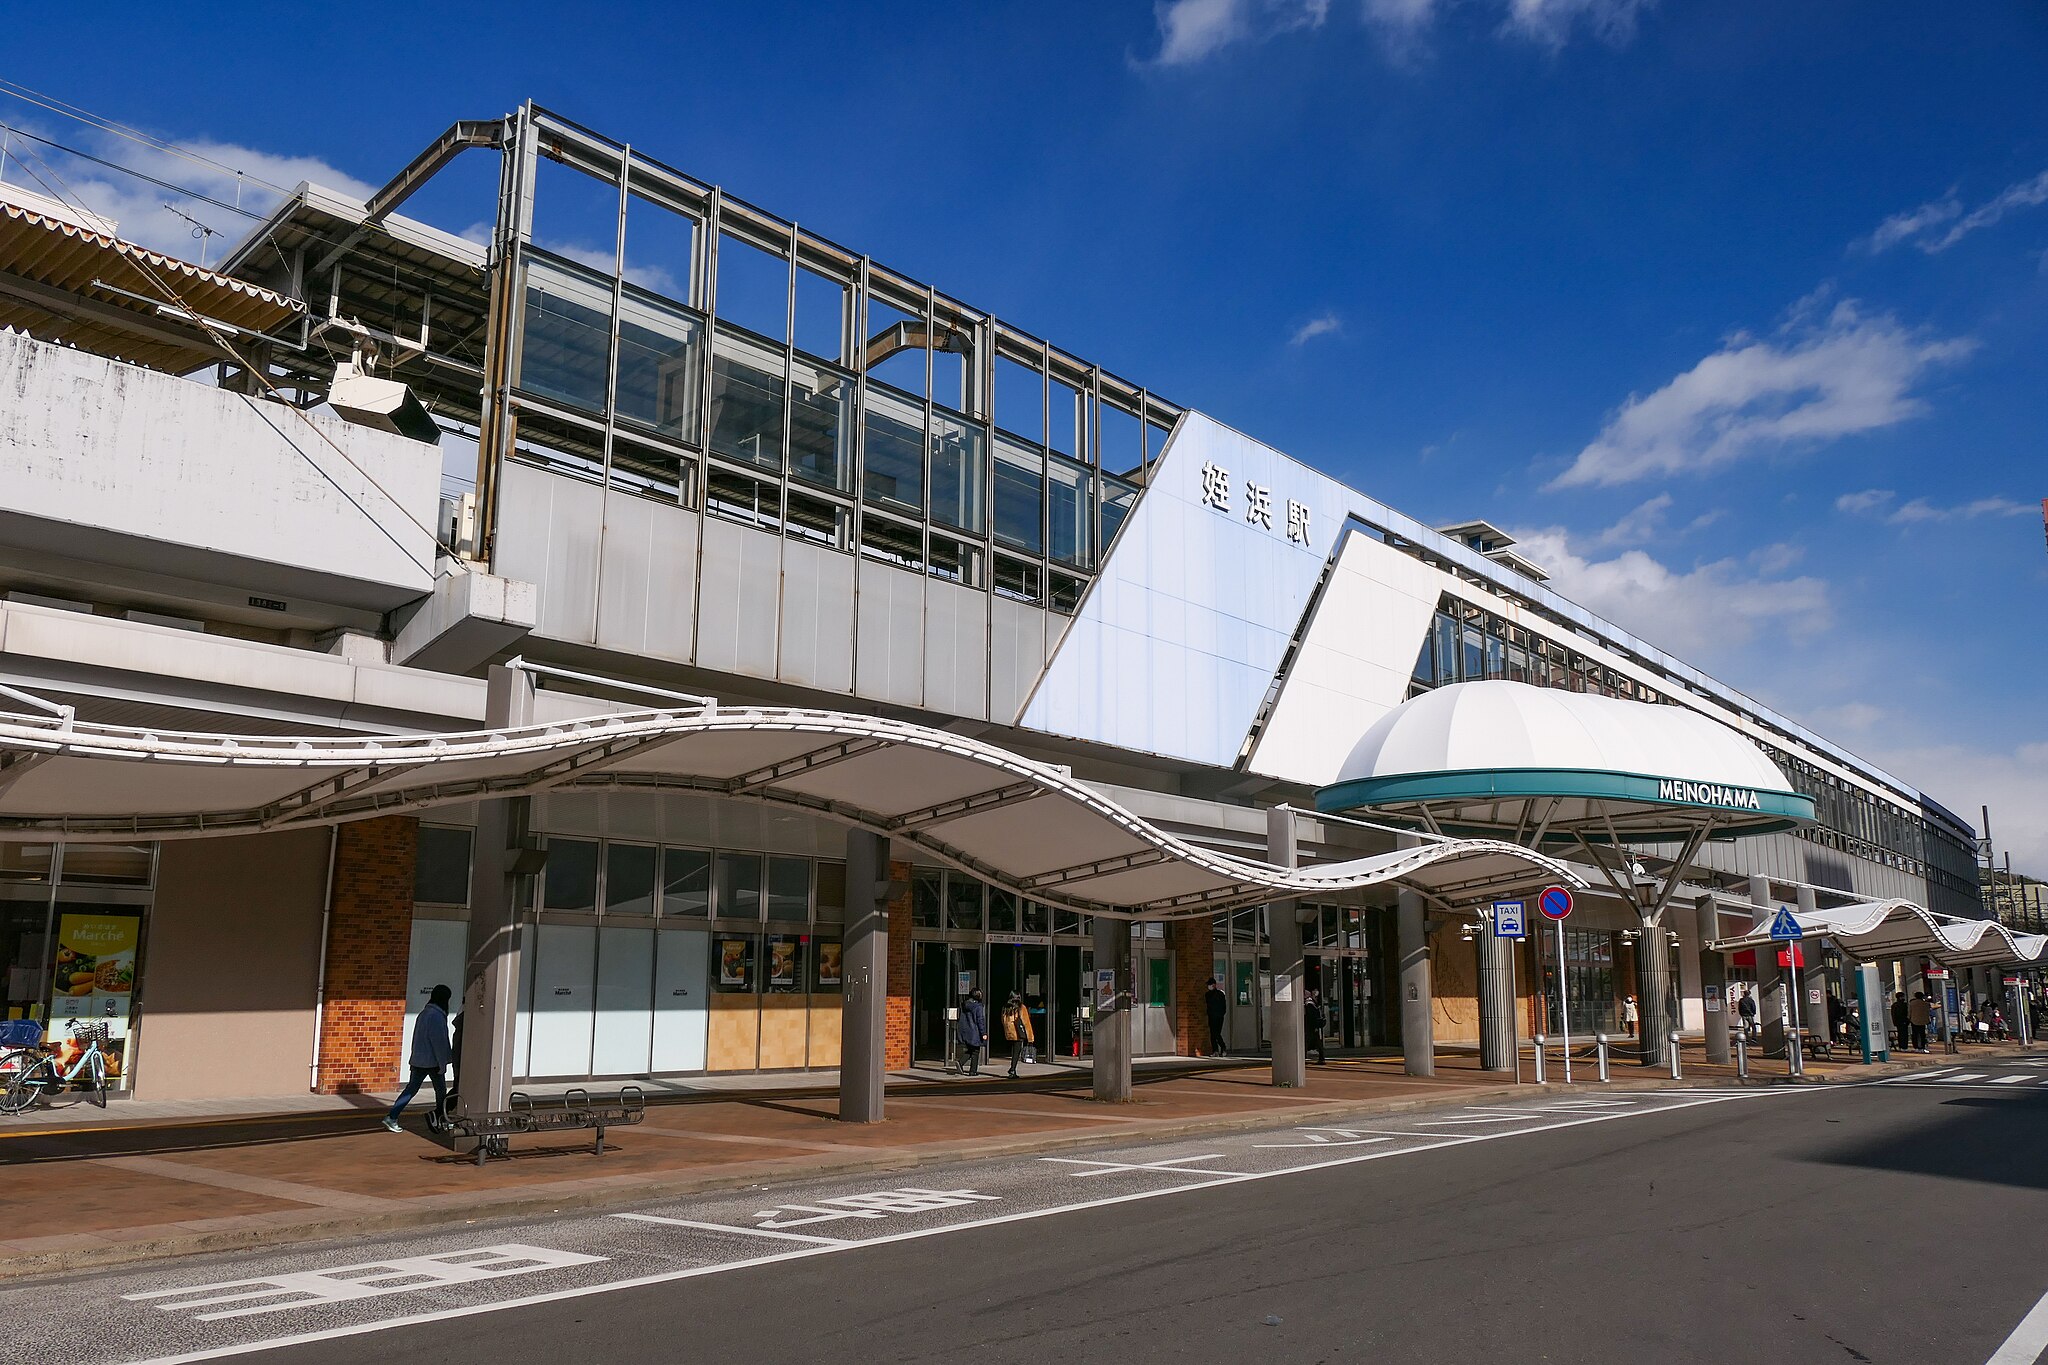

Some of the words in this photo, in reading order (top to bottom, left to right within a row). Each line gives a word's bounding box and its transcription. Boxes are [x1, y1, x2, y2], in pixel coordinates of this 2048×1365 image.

[1201, 459, 1311, 548] 姪浜駅
[1659, 779, 1761, 810] MEINOHAMA
[1499, 906, 1518, 915] TAXI
[73, 929, 125, 941] Marché
[1729, 986, 1737, 1015] Yakult
